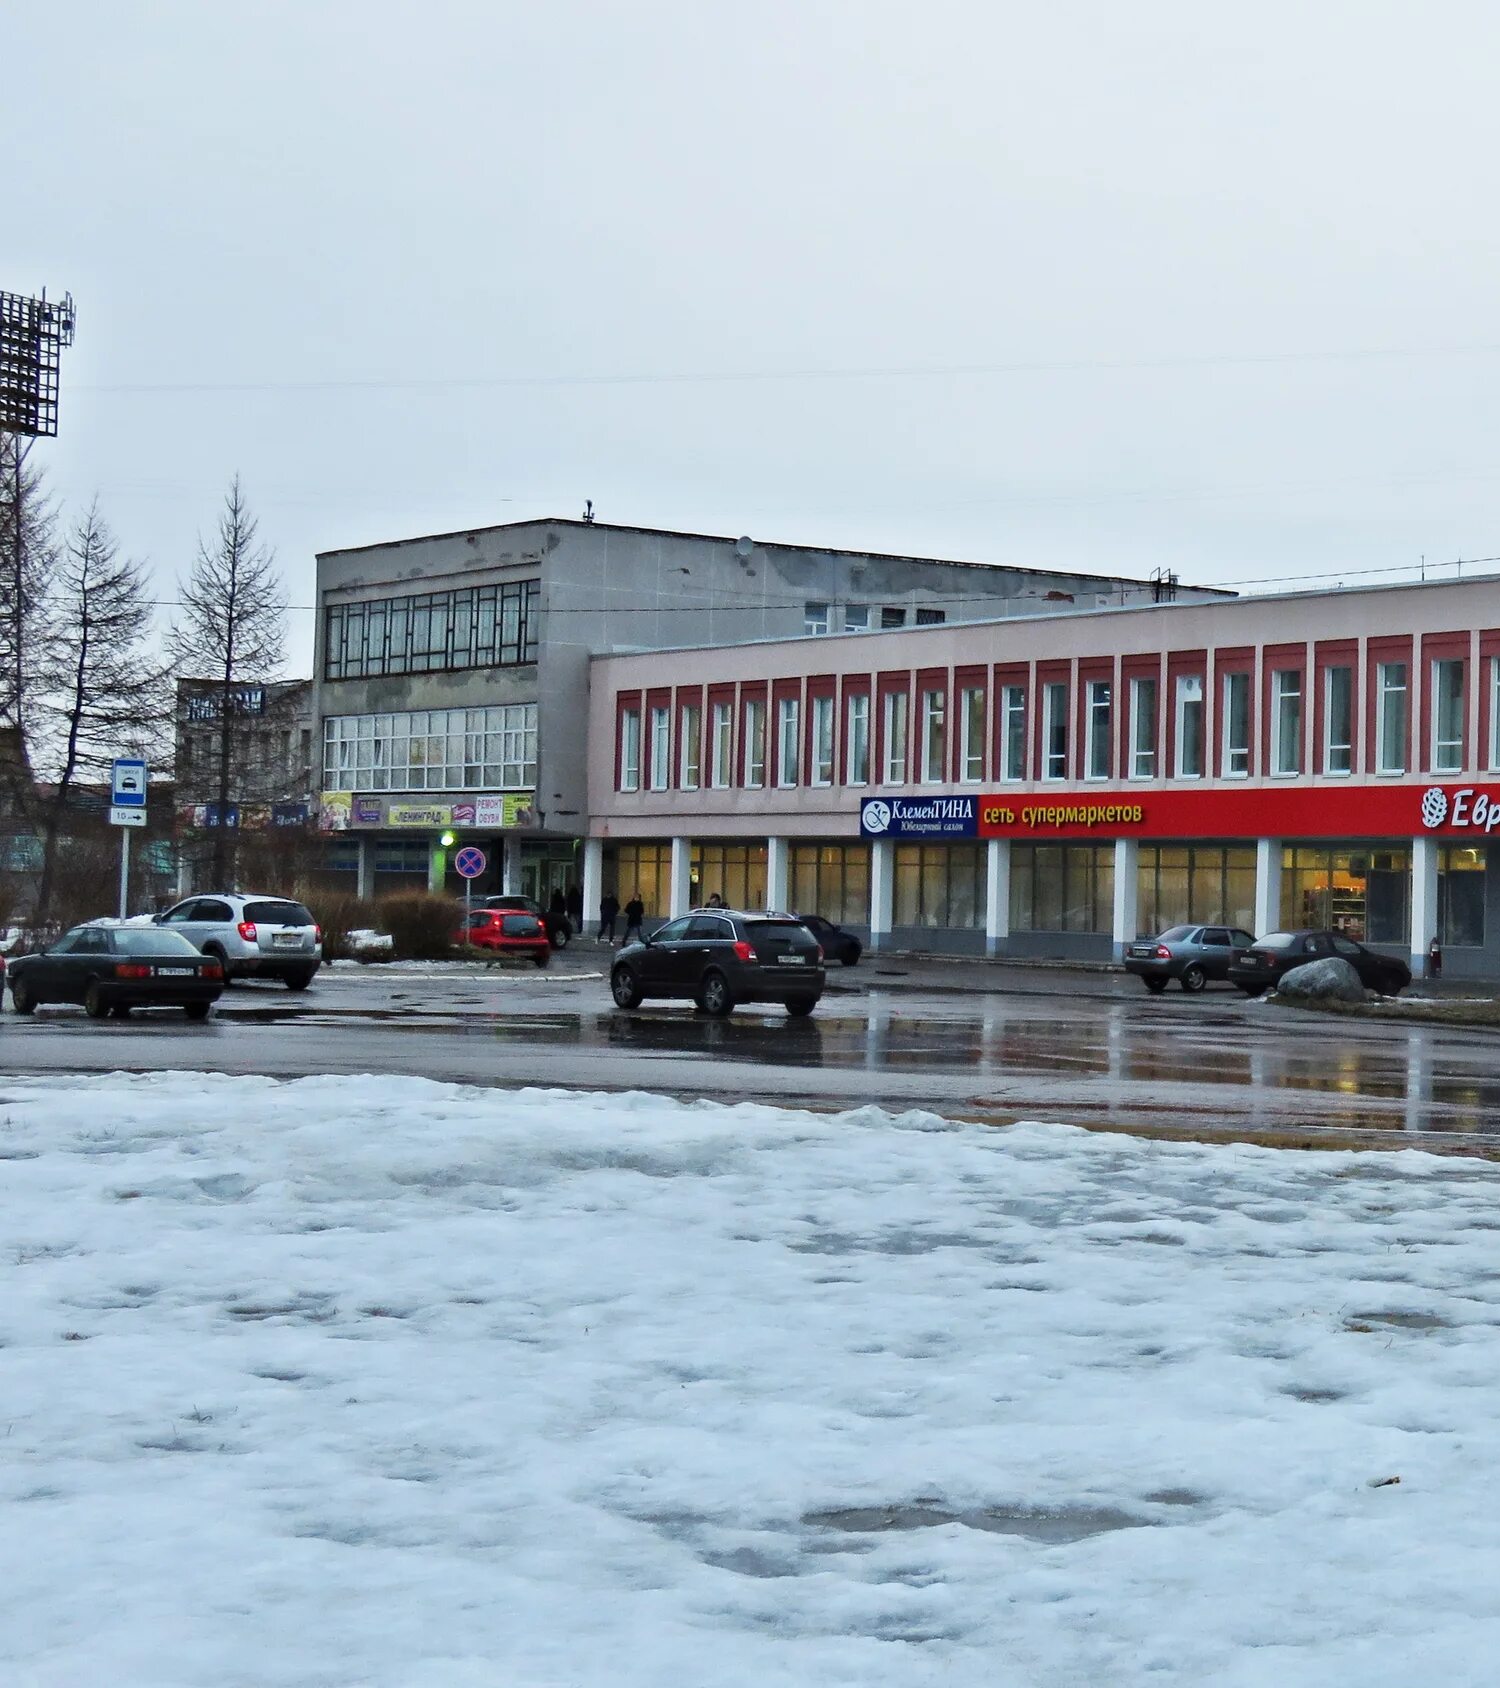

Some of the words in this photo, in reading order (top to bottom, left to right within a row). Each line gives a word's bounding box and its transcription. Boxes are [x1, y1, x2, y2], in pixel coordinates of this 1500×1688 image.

[476, 798, 502, 809] РЕМОНТ
[891, 799, 974, 820] КлеменТИНА
[478, 813, 500, 824] ОБУВИ
[983, 806, 1015, 824] сеть
[1021, 804, 1143, 828] супермаркетов
[900, 820, 942, 834] Ювелирный
[943, 822, 964, 832] салон
